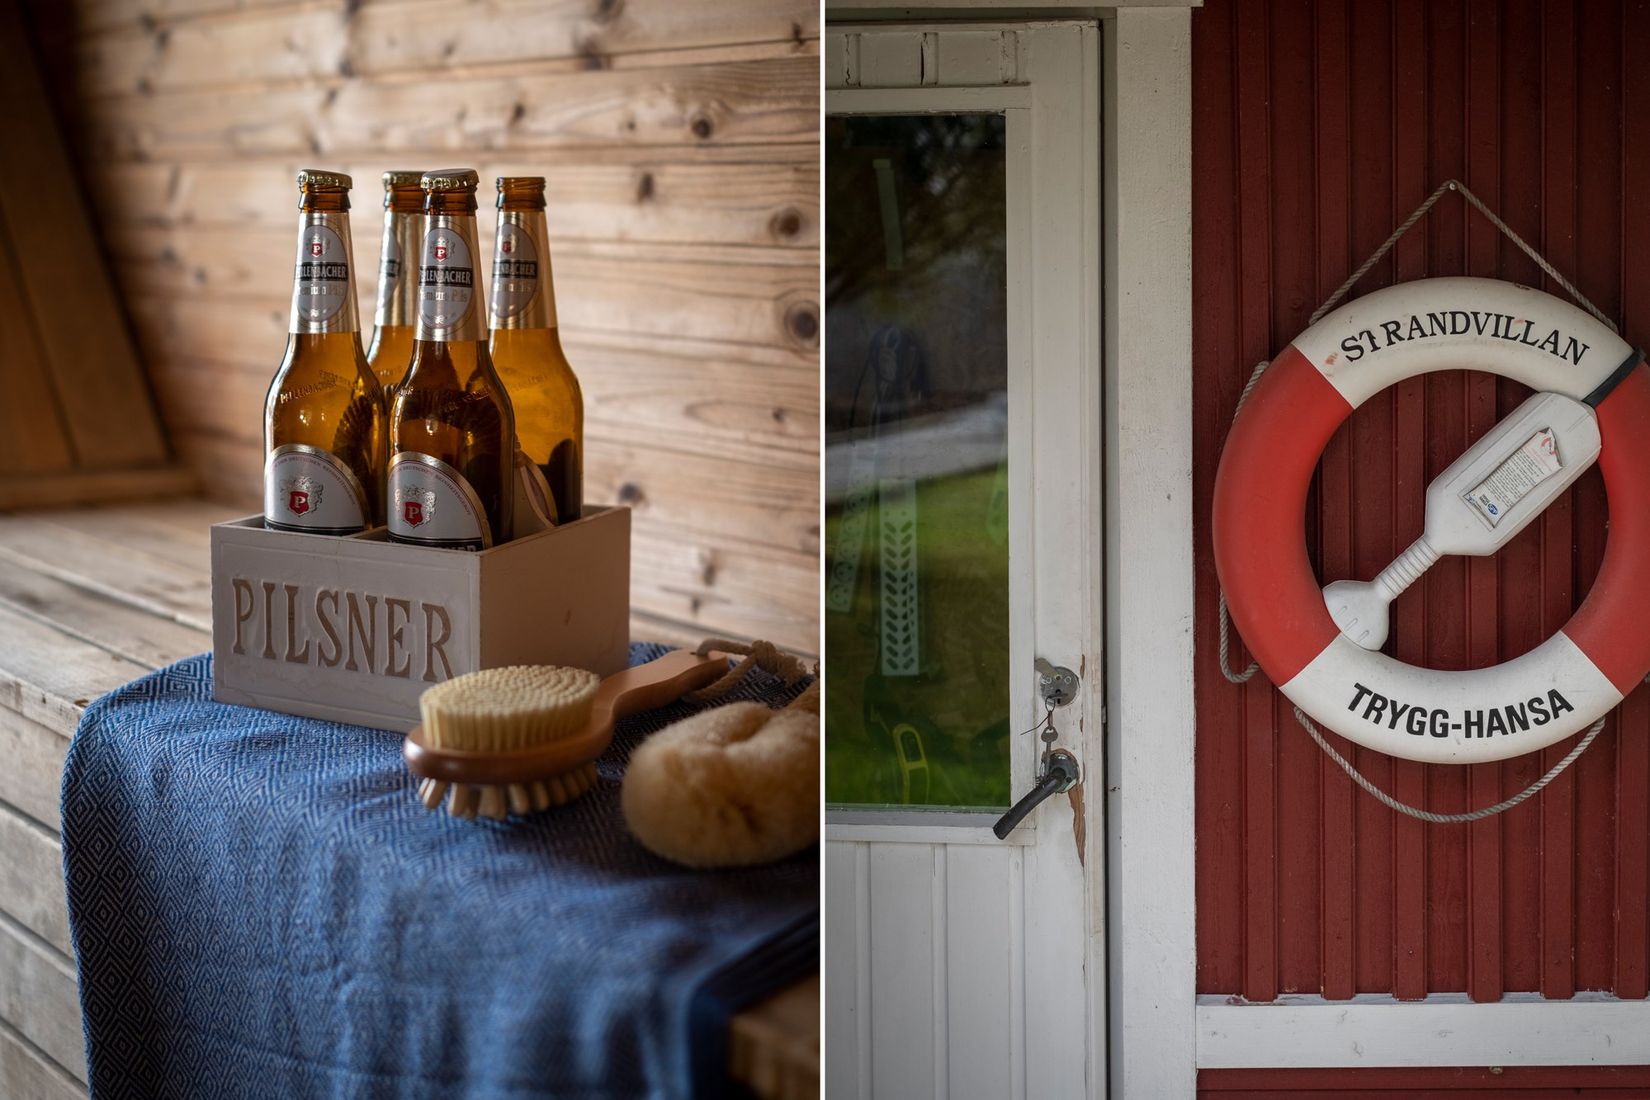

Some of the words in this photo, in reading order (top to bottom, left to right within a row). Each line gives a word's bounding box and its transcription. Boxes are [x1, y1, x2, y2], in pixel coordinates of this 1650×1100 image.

[313, 245, 320, 253] P
[437, 248, 445, 257] P
[1341, 311, 1590, 366] STRANDVILLAN
[294, 496, 306, 508] P
[408, 506, 420, 519] P
[232, 578, 454, 682] PILSNER
[1348, 682, 1575, 739] TRYGG-HANSA
